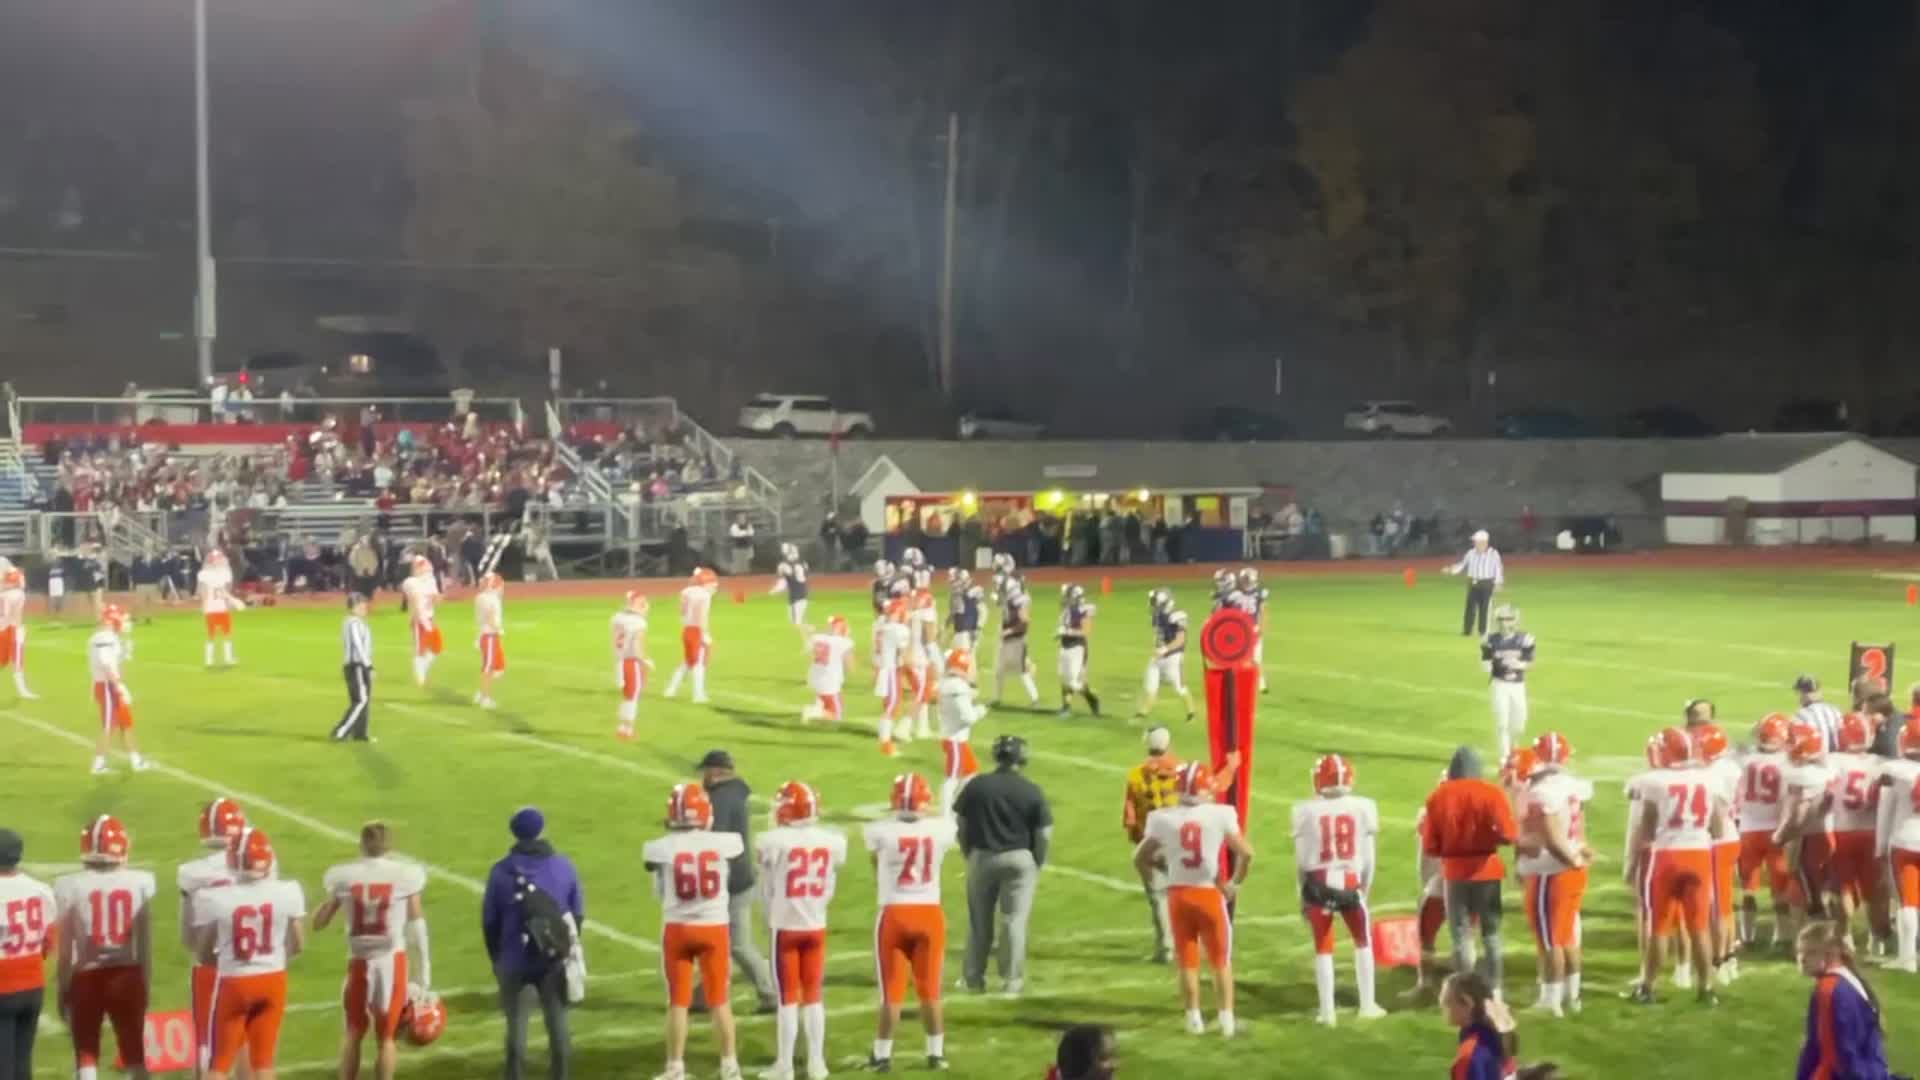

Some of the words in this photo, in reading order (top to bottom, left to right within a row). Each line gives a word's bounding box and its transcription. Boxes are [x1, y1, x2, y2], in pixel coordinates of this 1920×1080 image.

[1860, 648, 1888, 695] 2
[1668, 784, 1708, 829] 74
[1746, 763, 1782, 804] 19
[897, 836, 934, 886] 71
[1180, 822, 1203, 868] 9
[1319, 815, 1355, 861] 18
[673, 850, 721, 900] 66
[785, 847, 830, 898] 23
[3, 895, 43, 955] 59
[89, 889, 134, 945] 10
[231, 902, 274, 960] 61
[350, 882, 394, 936] 17
